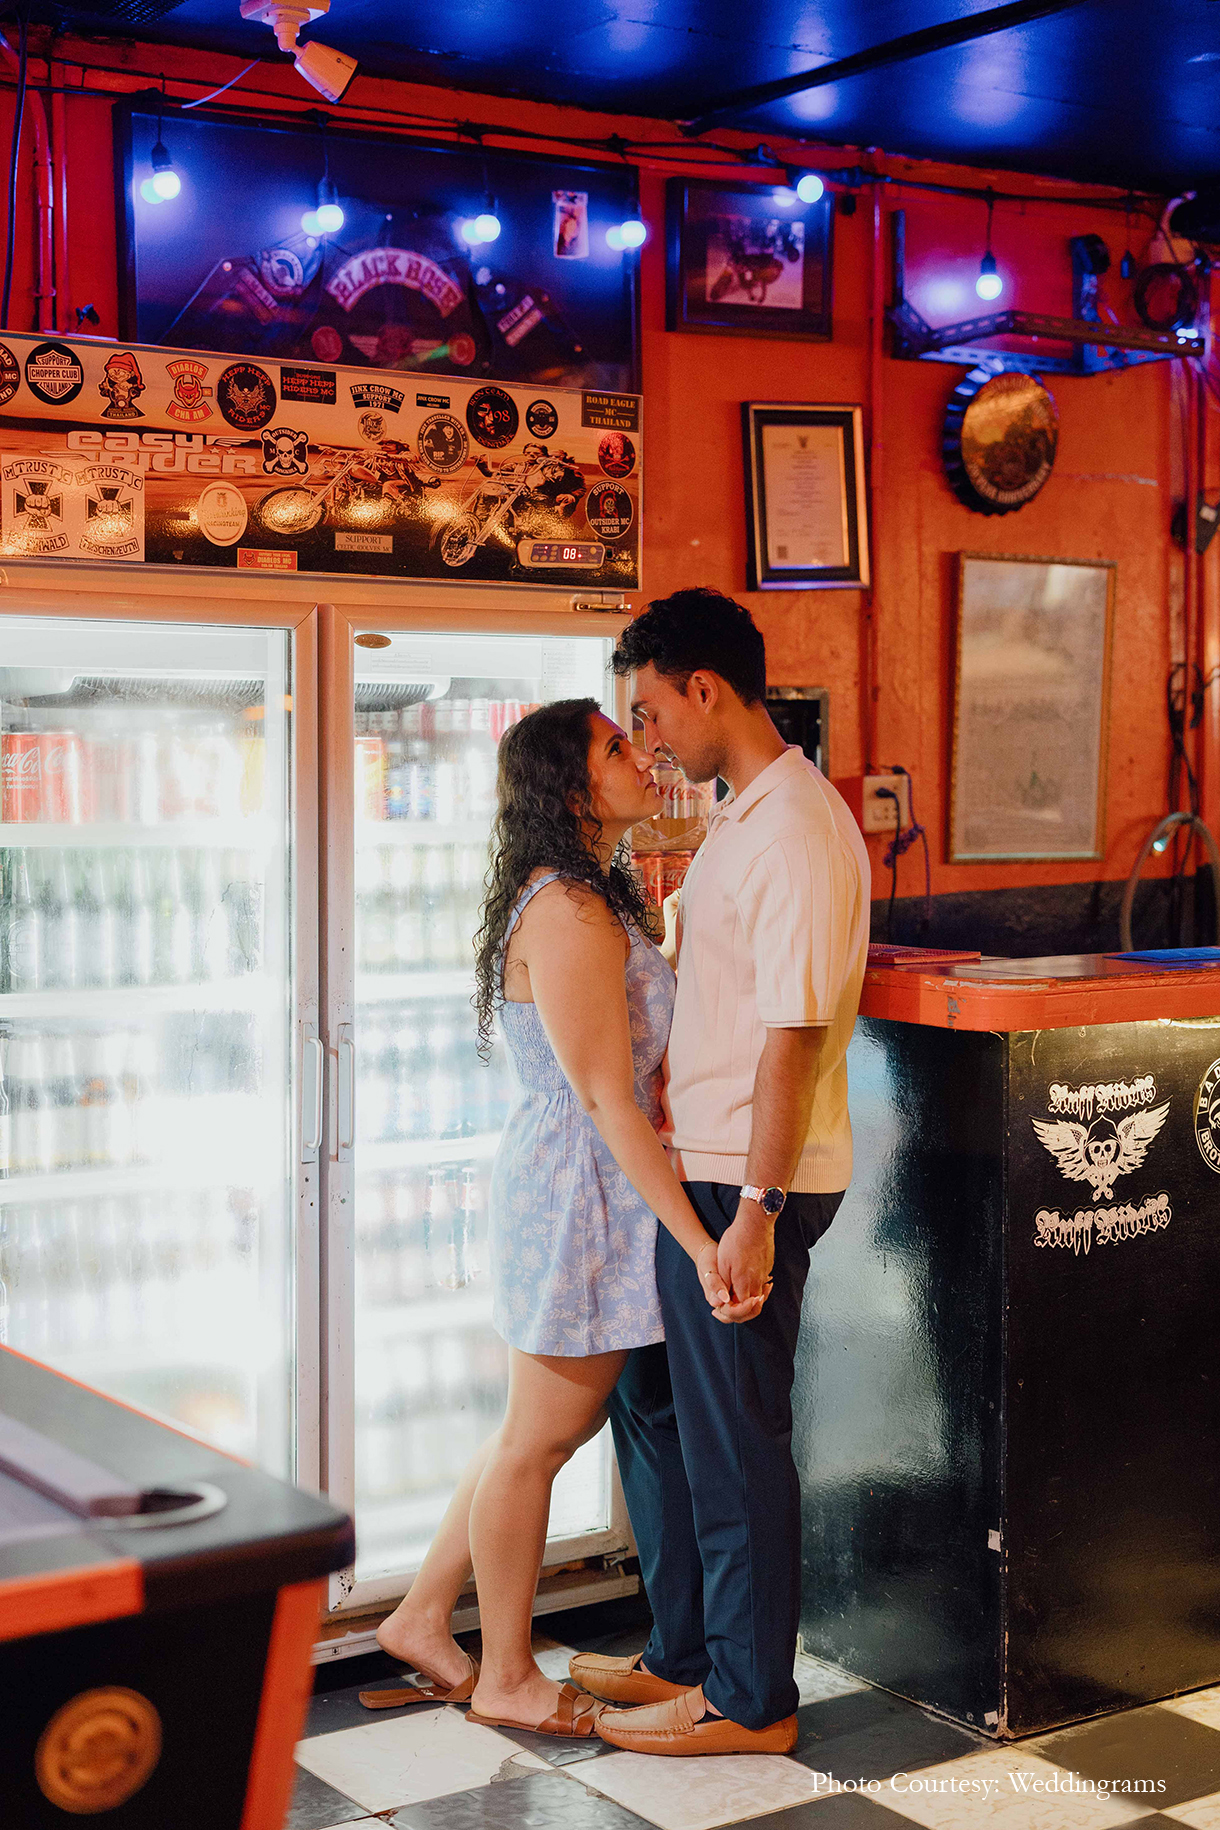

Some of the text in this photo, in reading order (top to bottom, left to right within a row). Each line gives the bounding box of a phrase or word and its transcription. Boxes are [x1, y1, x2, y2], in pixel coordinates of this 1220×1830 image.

[41, 355, 67, 365] SUPPORT
[31, 368, 78, 379] CHOPPER CLUB
[171, 363, 204, 375] DIABLOS
[222, 367, 271, 386] HEPP HEPP
[282, 376, 335, 388] HEPP HEPP
[283, 385, 319, 394] RIDERS
[320, 388, 334, 396] MC
[351, 385, 404, 400] JINX CROW MC
[362, 394, 391, 403] SUPPORT
[586, 395, 635, 408] ROAD EAGLE
[174, 407, 205, 420] CHA AM
[228, 409, 266, 424] RIDERS
[493, 409, 510, 422] 98
[604, 407, 617, 416] MC
[590, 416, 631, 427] THAILAND
[5, 469, 13, 478] M
[15, 461, 59, 475] TRUST
[88, 467, 129, 480] TRUST
[133, 478, 142, 488] C
[593, 482, 624, 496] SUPPORT
[590, 518, 620, 526] OUTSIDER
[602, 526, 620, 534] KRABI
[345, 535, 382, 544] SUPPORT
